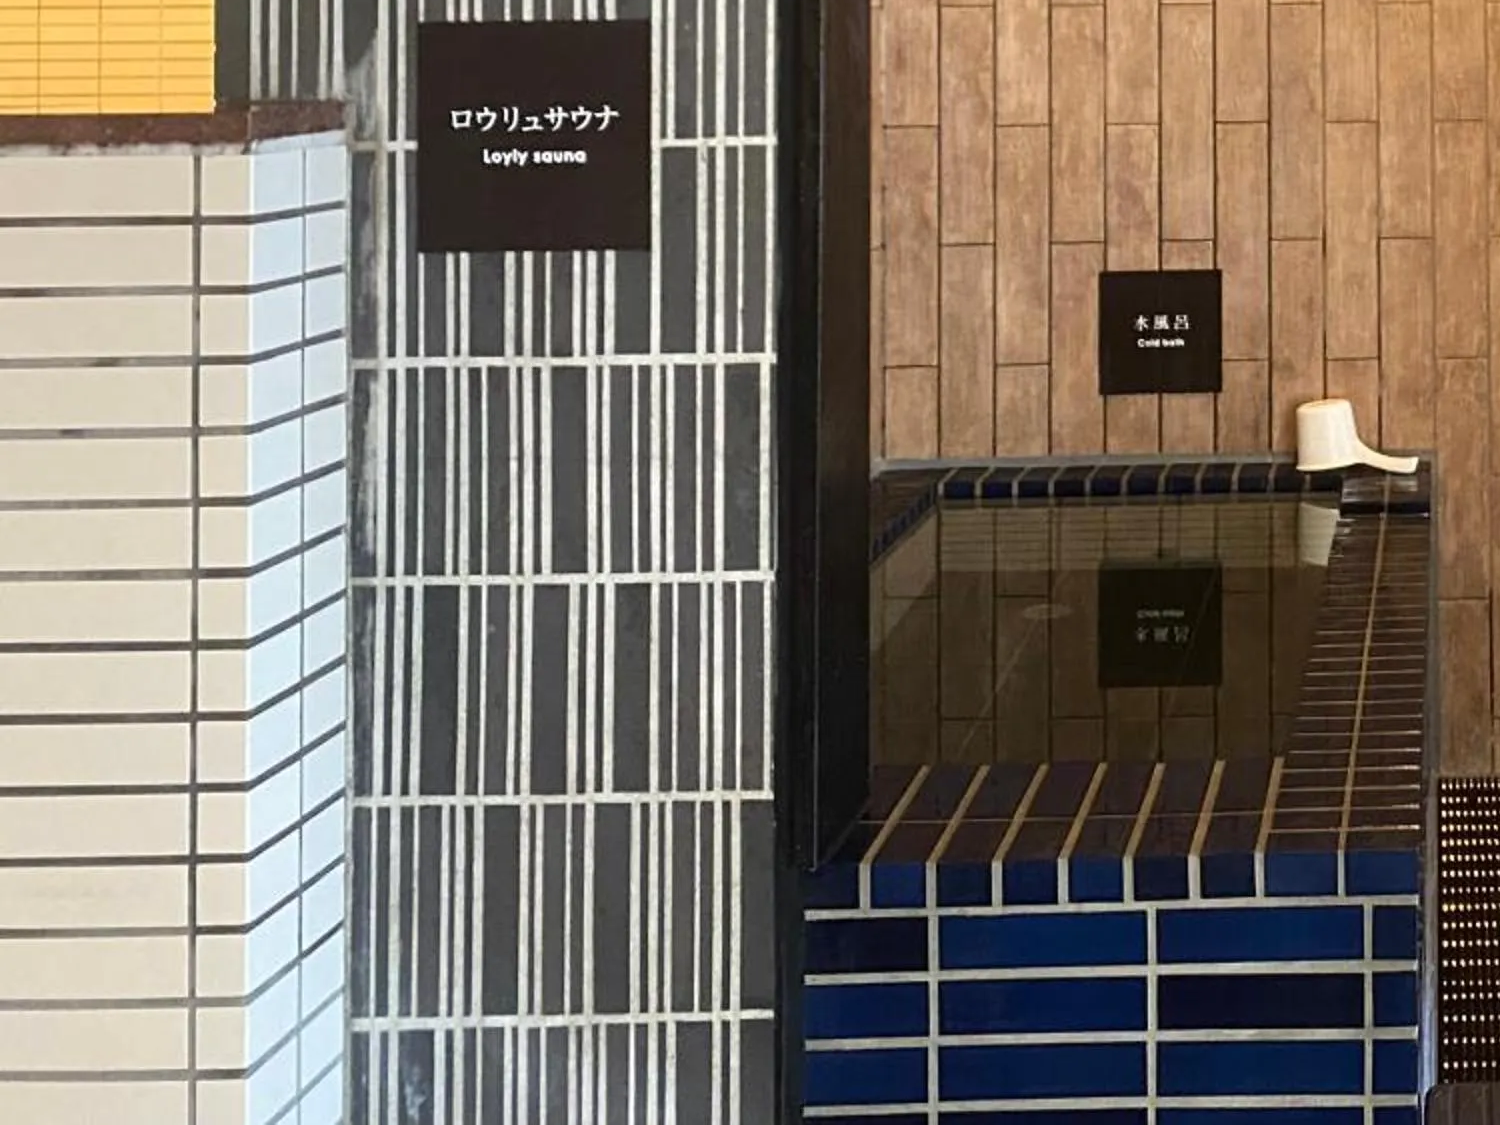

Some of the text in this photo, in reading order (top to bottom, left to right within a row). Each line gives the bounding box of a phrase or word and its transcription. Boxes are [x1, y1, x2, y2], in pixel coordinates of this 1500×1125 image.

[450, 105, 620, 132] ロウリュサウナ
[482, 148, 588, 167] Loyly sauna
